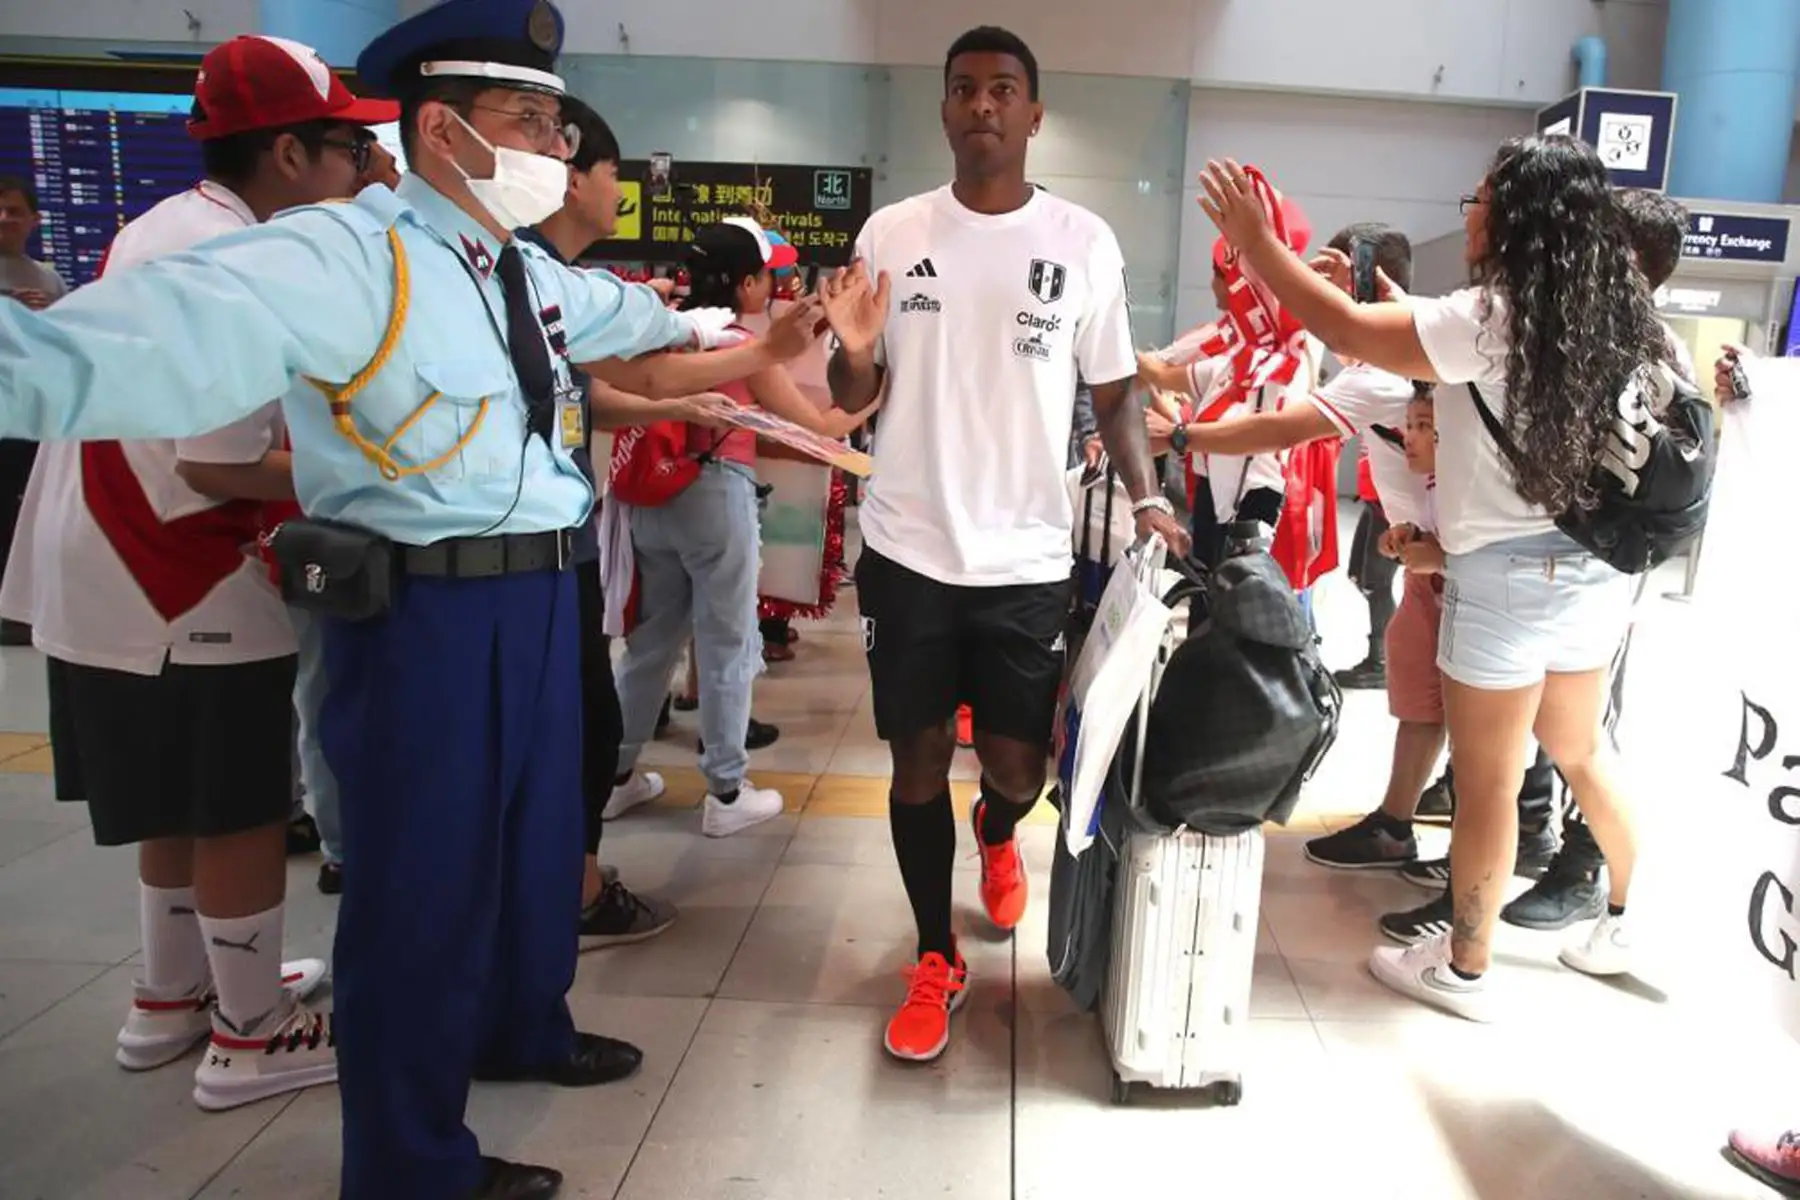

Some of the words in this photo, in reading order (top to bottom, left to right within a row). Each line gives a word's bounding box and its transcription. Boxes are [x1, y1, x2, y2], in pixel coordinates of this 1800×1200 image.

[823, 172, 844, 194] 北
[817, 194, 847, 205] North
[1721, 233, 1773, 252] Exchange
[1016, 311, 1056, 332] Claro
